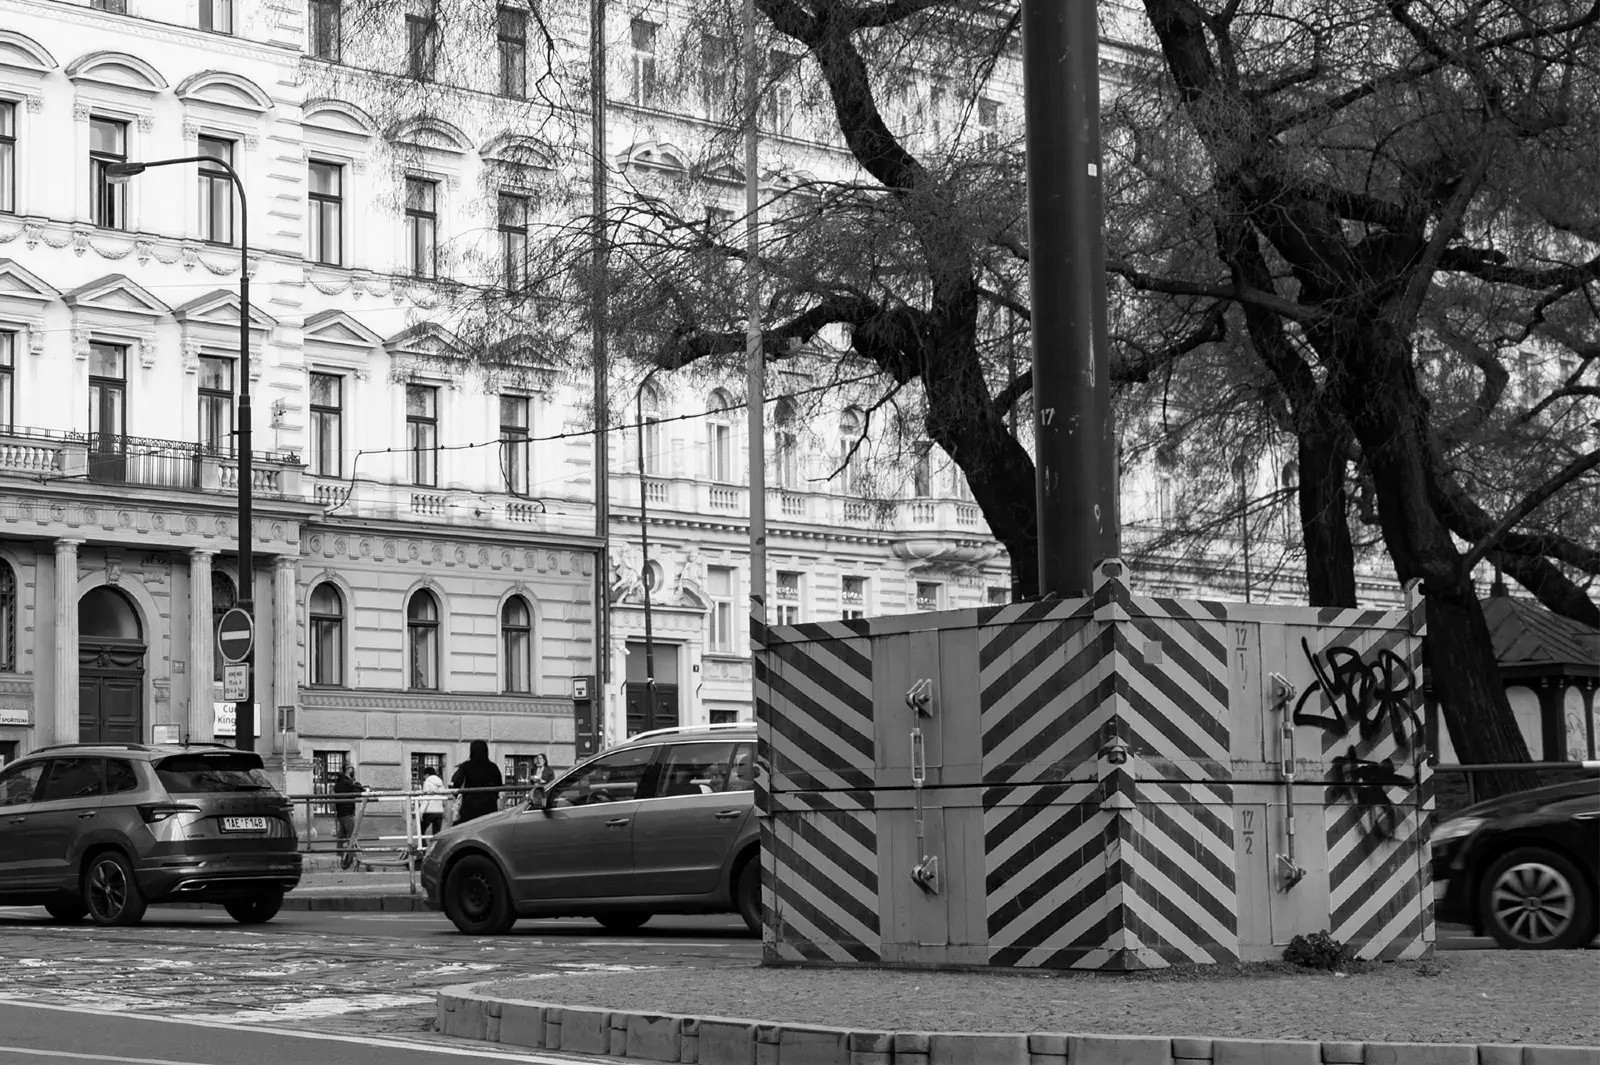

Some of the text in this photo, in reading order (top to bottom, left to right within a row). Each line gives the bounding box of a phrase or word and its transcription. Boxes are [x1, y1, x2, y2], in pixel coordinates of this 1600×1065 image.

[1040, 407, 1056, 426] 17
[1235, 627, 1247, 646] 17
[226, 818, 263, 828] 1AE F148
[1241, 810, 1254, 829] 17
[1245, 838, 1253, 855] 2
